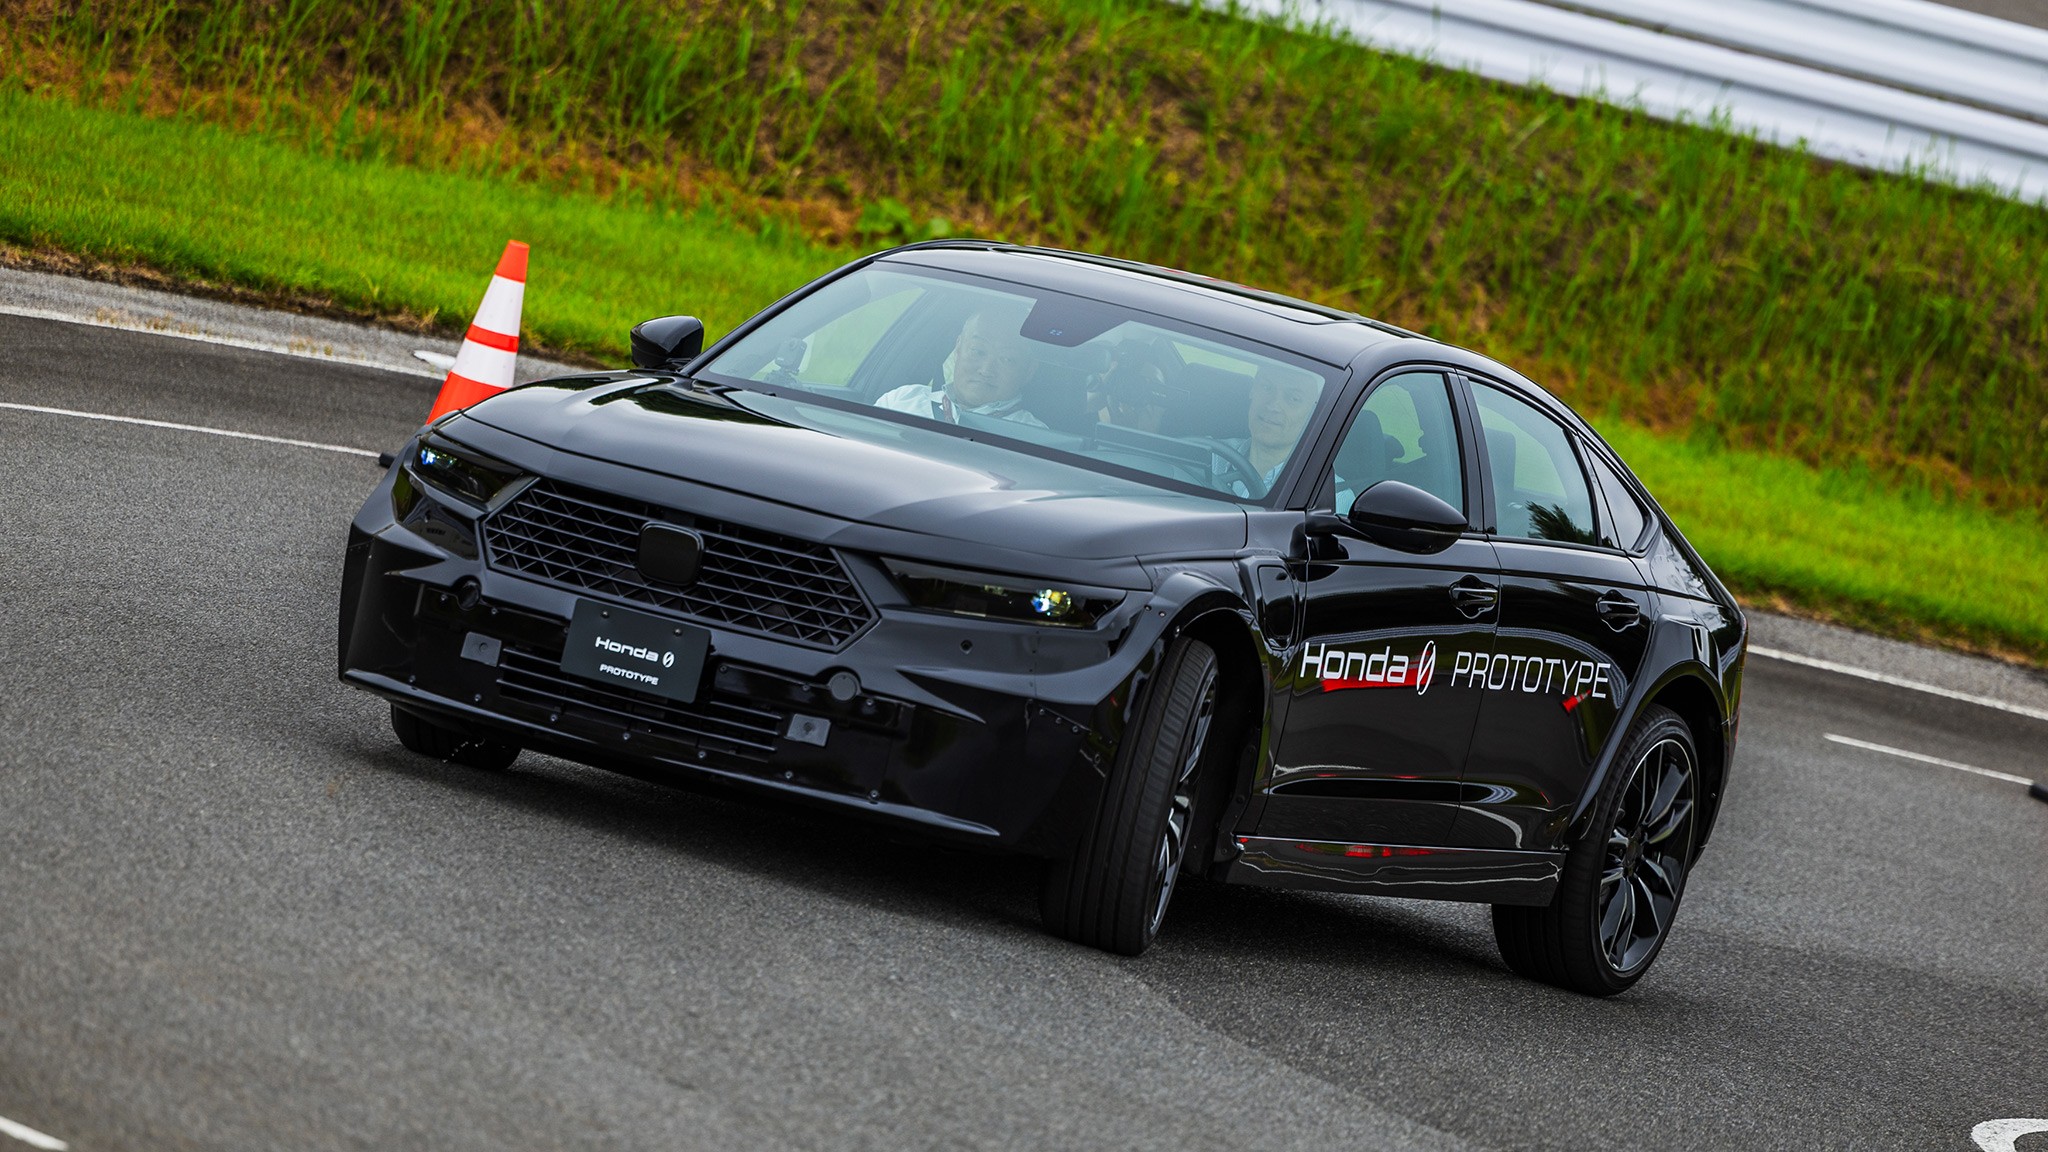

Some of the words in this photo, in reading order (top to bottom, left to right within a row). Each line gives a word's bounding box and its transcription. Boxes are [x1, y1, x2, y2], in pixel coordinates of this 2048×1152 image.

[595, 636, 660, 663] Honda
[599, 663, 660, 685] PROTOTYPE
[1300, 642, 1409, 683] Honda
[1450, 651, 1611, 699] PROTOTYPE
